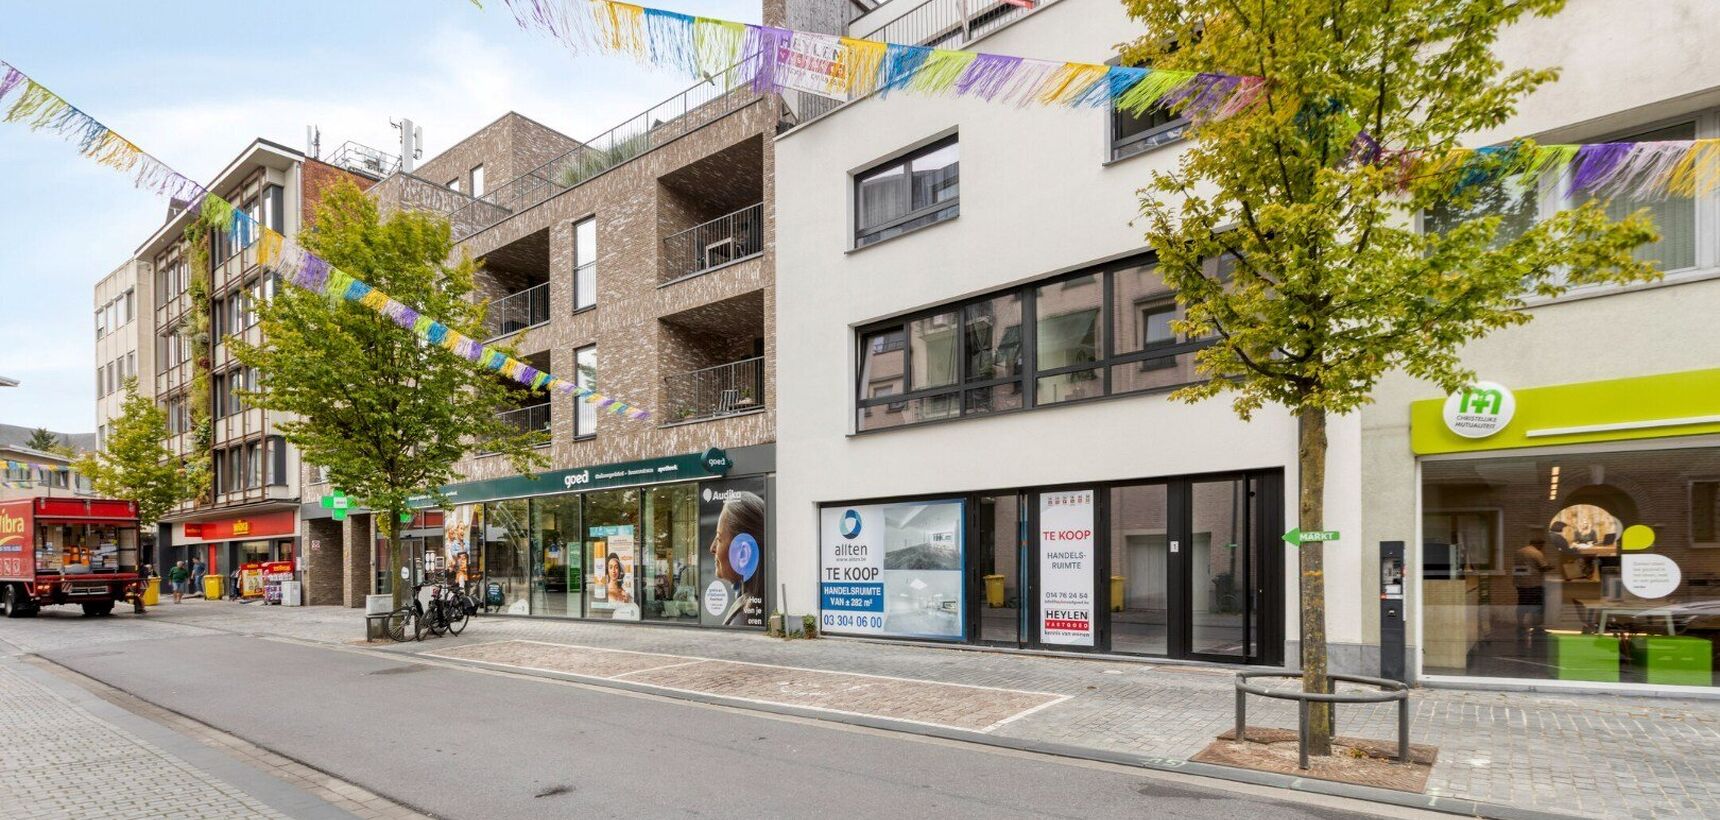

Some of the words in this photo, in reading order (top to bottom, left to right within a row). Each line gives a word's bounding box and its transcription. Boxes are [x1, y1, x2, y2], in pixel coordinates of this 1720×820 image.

[708, 457, 725, 466] goed
[564, 470, 589, 488] goed
[712, 489, 742, 500] Audika
[0, 508, 24, 533] ibra
[1043, 531, 1056, 541] TE
[1058, 529, 1091, 541] KOOP
[1300, 532, 1334, 541] MARKT
[835, 544, 867, 555] allten
[1047, 551, 1086, 560] HANDELS-
[1052, 562, 1081, 570] RUIMTE
[826, 567, 840, 580] TE
[844, 567, 879, 581] KOOP
[824, 587, 881, 595] HANDELSRUIMTE
[830, 598, 845, 606] VAN
[850, 598, 863, 607] 282
[756, 606, 762, 616] je
[1046, 610, 1088, 620] HEYLEN
[824, 614, 834, 626] 03
[837, 615, 854, 627] 304
[856, 616, 868, 627] 06
[870, 616, 882, 628] 00
